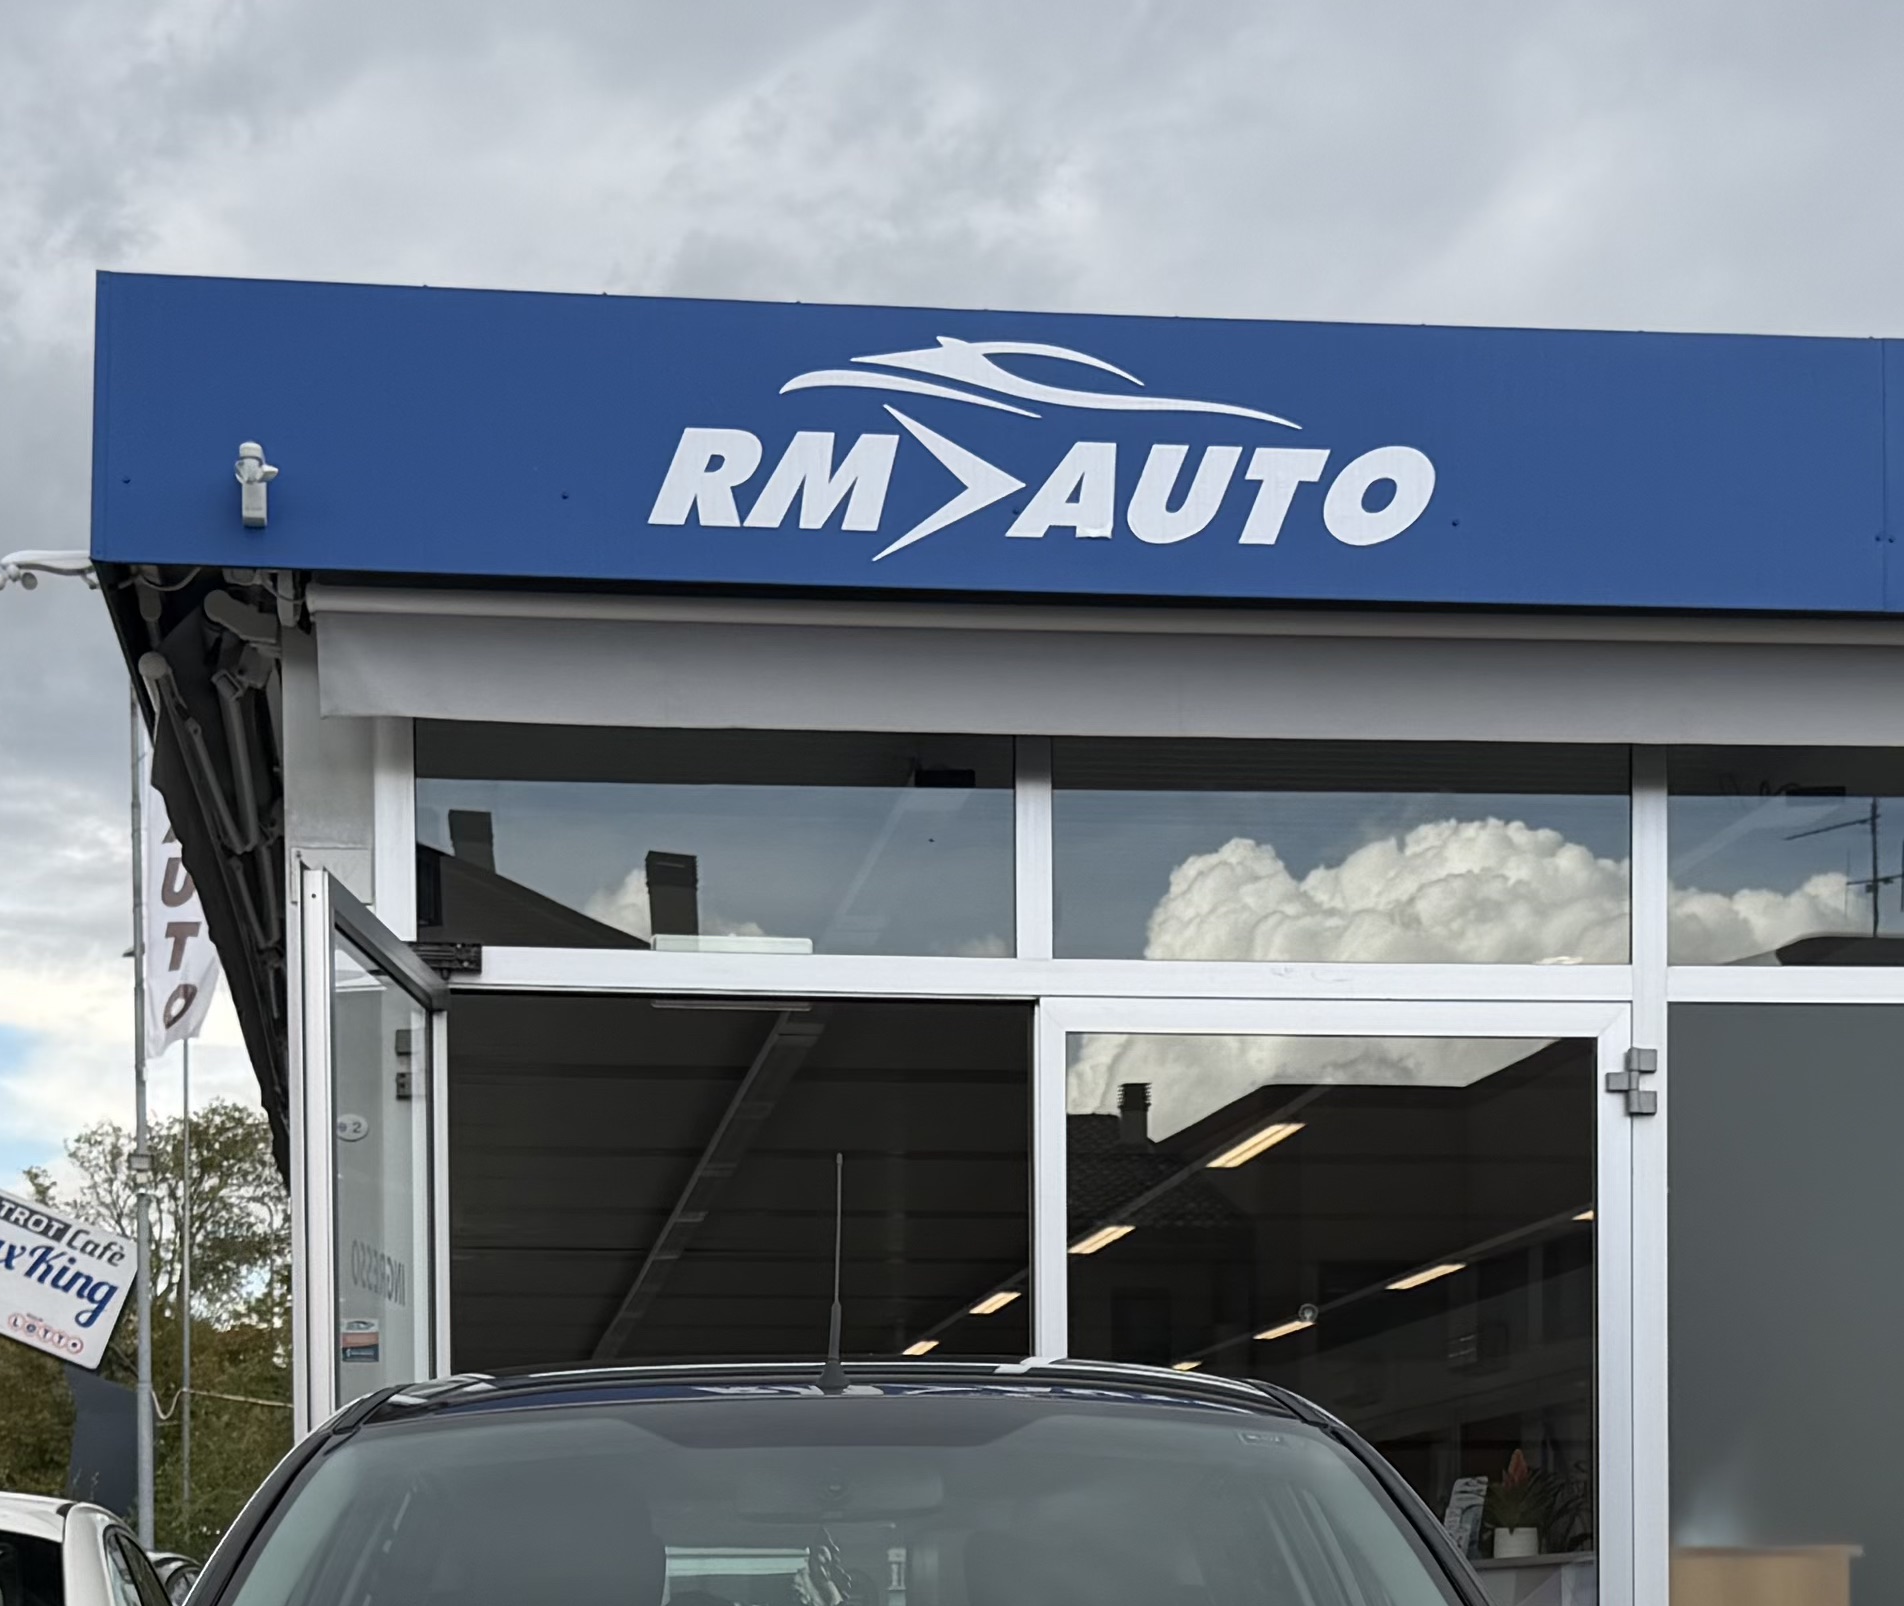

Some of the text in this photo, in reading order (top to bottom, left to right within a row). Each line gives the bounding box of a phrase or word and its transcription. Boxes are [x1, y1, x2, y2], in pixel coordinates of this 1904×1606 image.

[1004, 441, 1437, 547] AUTO
[161, 824, 203, 1031] UTO
[10, 1315, 82, 1353] LOTTO
